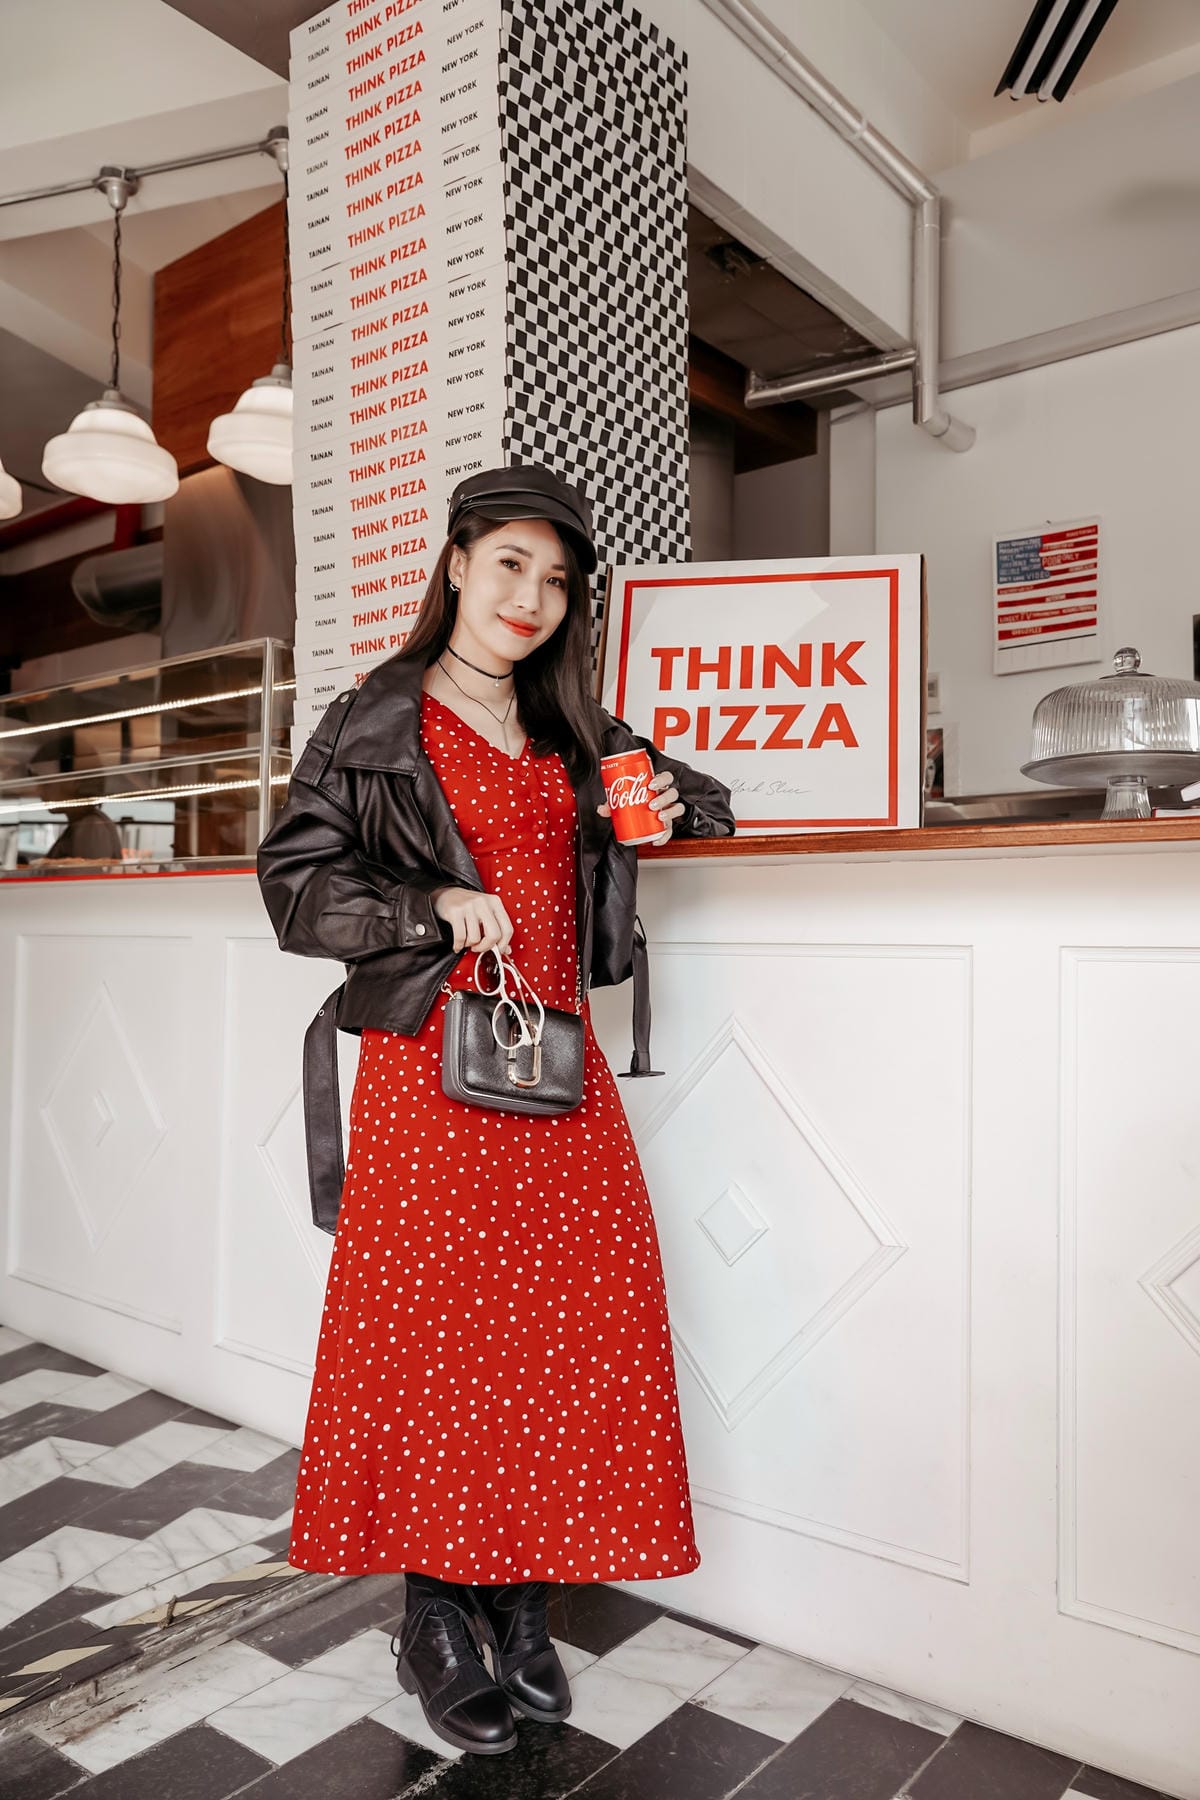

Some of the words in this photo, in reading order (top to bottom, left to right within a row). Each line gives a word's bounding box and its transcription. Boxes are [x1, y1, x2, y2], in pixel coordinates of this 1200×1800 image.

[308, 17, 330, 34] TAINAN
[345, 14, 381, 44] THINK
[447, 31, 463, 45] NEW
[464, 20, 484, 35] YORK
[308, 46, 329, 62] TAINAN
[346, 45, 382, 74] THINK
[386, 21, 423, 51] PIZZA
[442, 59, 458, 73] NEW
[459, 48, 478, 64] YORK
[308, 73, 330, 89] TAINAN
[347, 73, 385, 101] THINK
[389, 50, 426, 79] PIZZA
[440, 90, 456, 104] NEW
[458, 80, 477, 95] YORK
[306, 106, 328, 123] TAINAN
[345, 103, 382, 129] THINK
[386, 81, 422, 108] PIZZA
[441, 121, 457, 134] NEW
[459, 111, 478, 125] YORK
[307, 131, 329, 146] TAINAN
[344, 131, 381, 159] THINK
[384, 110, 421, 138] PIZZA
[344, 161, 381, 186] THINK
[385, 140, 422, 167] PIZZA
[443, 153, 459, 166] NEW
[460, 144, 480, 158] YORK
[307, 160, 328, 175] TAINAN
[306, 186, 328, 201] TAINAN
[346, 192, 382, 216] THINK
[387, 172, 423, 197] PIZZA
[446, 185, 462, 198] NEW
[463, 177, 483, 190] YORK
[308, 215, 330, 229] TAINAN
[347, 224, 384, 247] THINK
[388, 204, 425, 229] PIZZA
[446, 222, 462, 235] NEW
[464, 213, 483, 227] YORK
[309, 244, 331, 259] TAINAN
[349, 256, 385, 280] THINK
[390, 238, 426, 262] PIZZA
[447, 255, 463, 267] NEW
[465, 246, 484, 261] YORK
[310, 280, 332, 293] TAINAN
[350, 287, 386, 309] THINK
[391, 268, 427, 293] PIZZA
[449, 286, 465, 299] NEW
[467, 279, 487, 292] YORK
[311, 309, 333, 322] TAINAN
[351, 318, 387, 340] THINK
[392, 302, 428, 325] PIZZA
[448, 316, 464, 327] NEW
[466, 308, 486, 321] YORK
[312, 338, 334, 351] TAINAN
[351, 347, 387, 370] THINK
[392, 331, 428, 353] PIZZA
[449, 347, 464, 358] NEW
[465, 340, 486, 352] YORK
[312, 366, 334, 378] TAINAN
[351, 376, 387, 398] THINK
[391, 361, 428, 383] PIZZA
[447, 374, 463, 386] NEW
[464, 368, 484, 380] YORK
[312, 394, 334, 406] TAINAN
[349, 402, 386, 425] THINK
[390, 388, 427, 410] PIZZA
[448, 408, 463, 419] NEW
[465, 402, 485, 413] YORK
[311, 420, 332, 432] TAINAN
[350, 435, 386, 454] THINK
[391, 421, 427, 441] PIZZA
[445, 436, 461, 447] NEW
[462, 431, 482, 442] YORK
[310, 450, 333, 462] TAINAN
[348, 462, 385, 482] THINK
[389, 449, 426, 469] PIZZA
[446, 464, 462, 476] NEW
[463, 460, 482, 473] YORK
[310, 477, 332, 488] TAINAN
[349, 492, 386, 511] THINK
[390, 479, 427, 499] PIZZA
[312, 505, 333, 516] TAINAN
[351, 520, 387, 539] THINK
[392, 508, 428, 528] PIZZA
[313, 532, 335, 543] TAINAN
[351, 549, 387, 567] THINK
[391, 538, 427, 557] PIZZA
[314, 562, 335, 573] TAINAN
[351, 579, 387, 597] THINK
[390, 569, 427, 587] PIZZA
[314, 592, 335, 601] TAINAN
[315, 618, 336, 627] TAINAN
[352, 609, 387, 626] THINK
[312, 648, 333, 657] TAINAN
[350, 638, 385, 656] THINK
[651, 641, 867, 691] THINK
[314, 685, 335, 694] TAINAN
[653, 703, 859, 751] PIZZA
